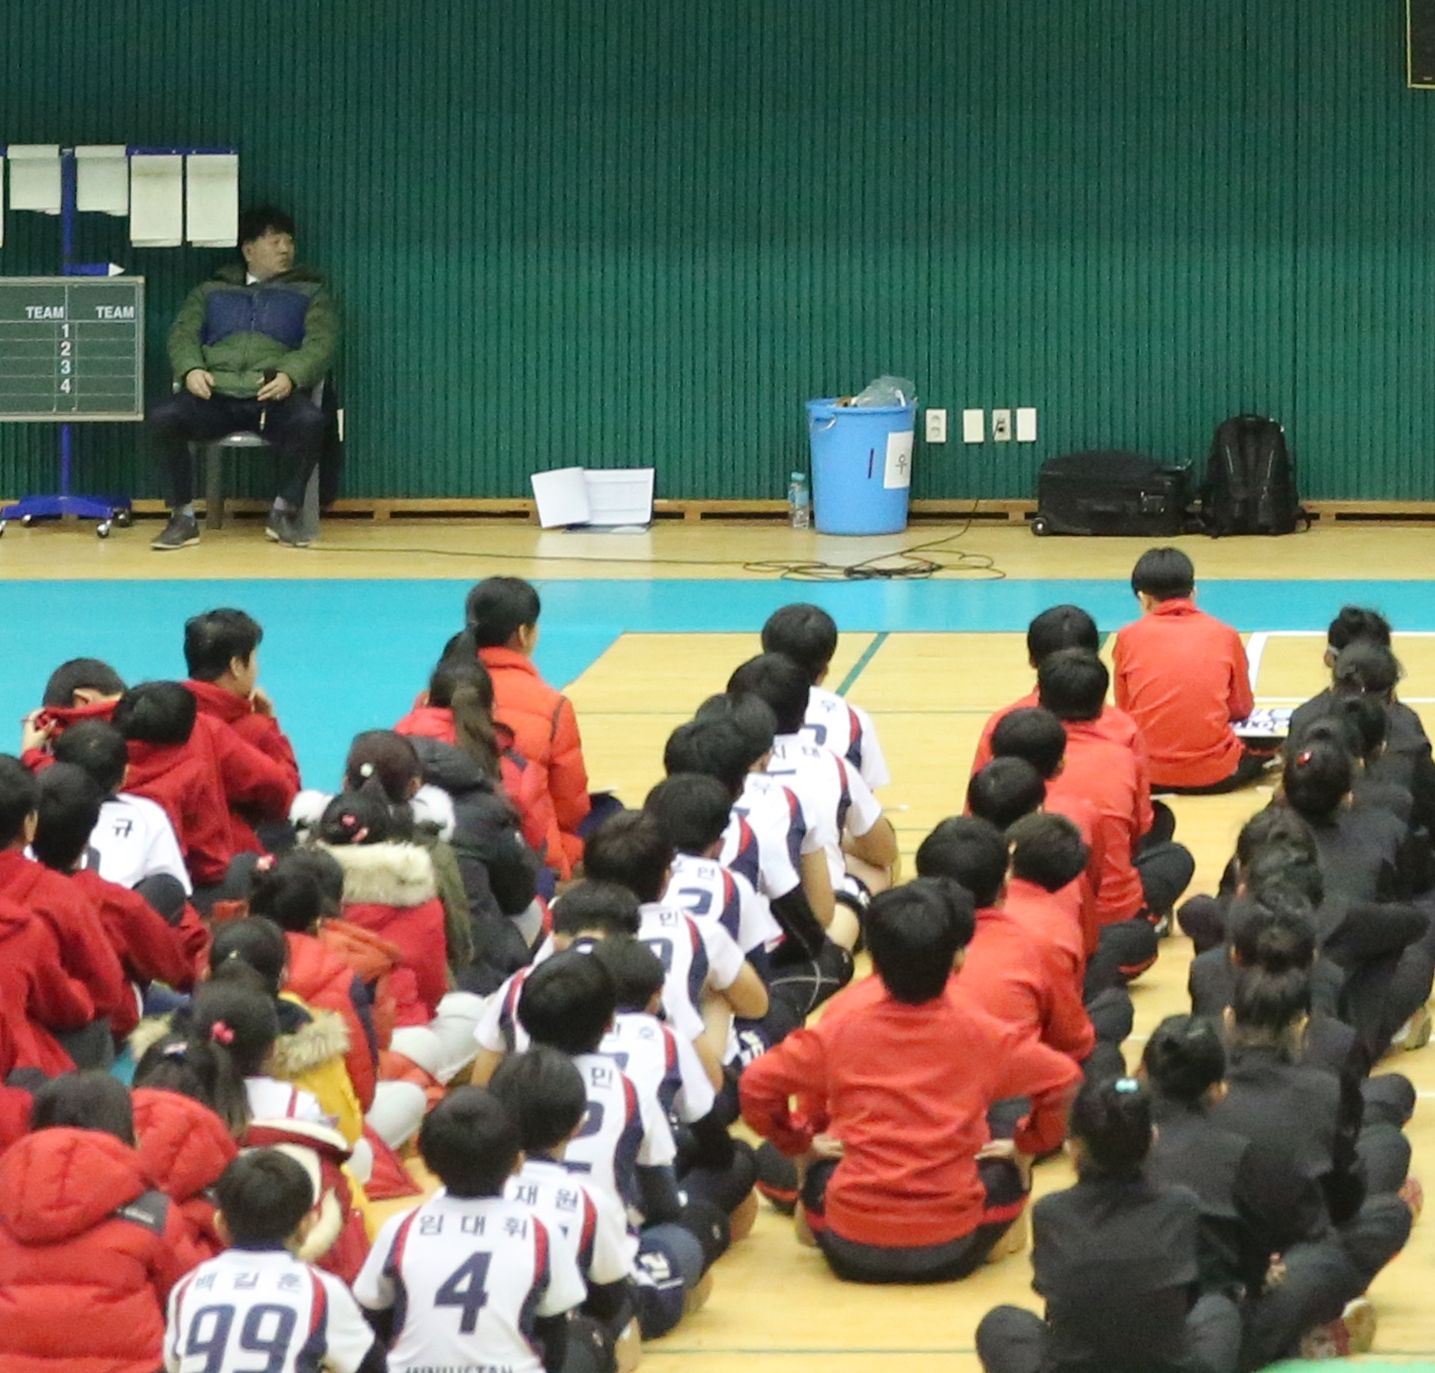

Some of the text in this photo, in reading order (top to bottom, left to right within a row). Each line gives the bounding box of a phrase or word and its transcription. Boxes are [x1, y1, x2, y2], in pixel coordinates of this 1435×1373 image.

[24, 305, 65, 320] TEAM
[95, 305, 135, 319] TEAM
[61, 323, 70, 339] 1
[60, 341, 72, 357] 2
[60, 359, 72, 375] 3
[60, 378, 72, 395] 4
[433, 1250, 494, 1336] 4
[185, 1302, 299, 1373] 99
